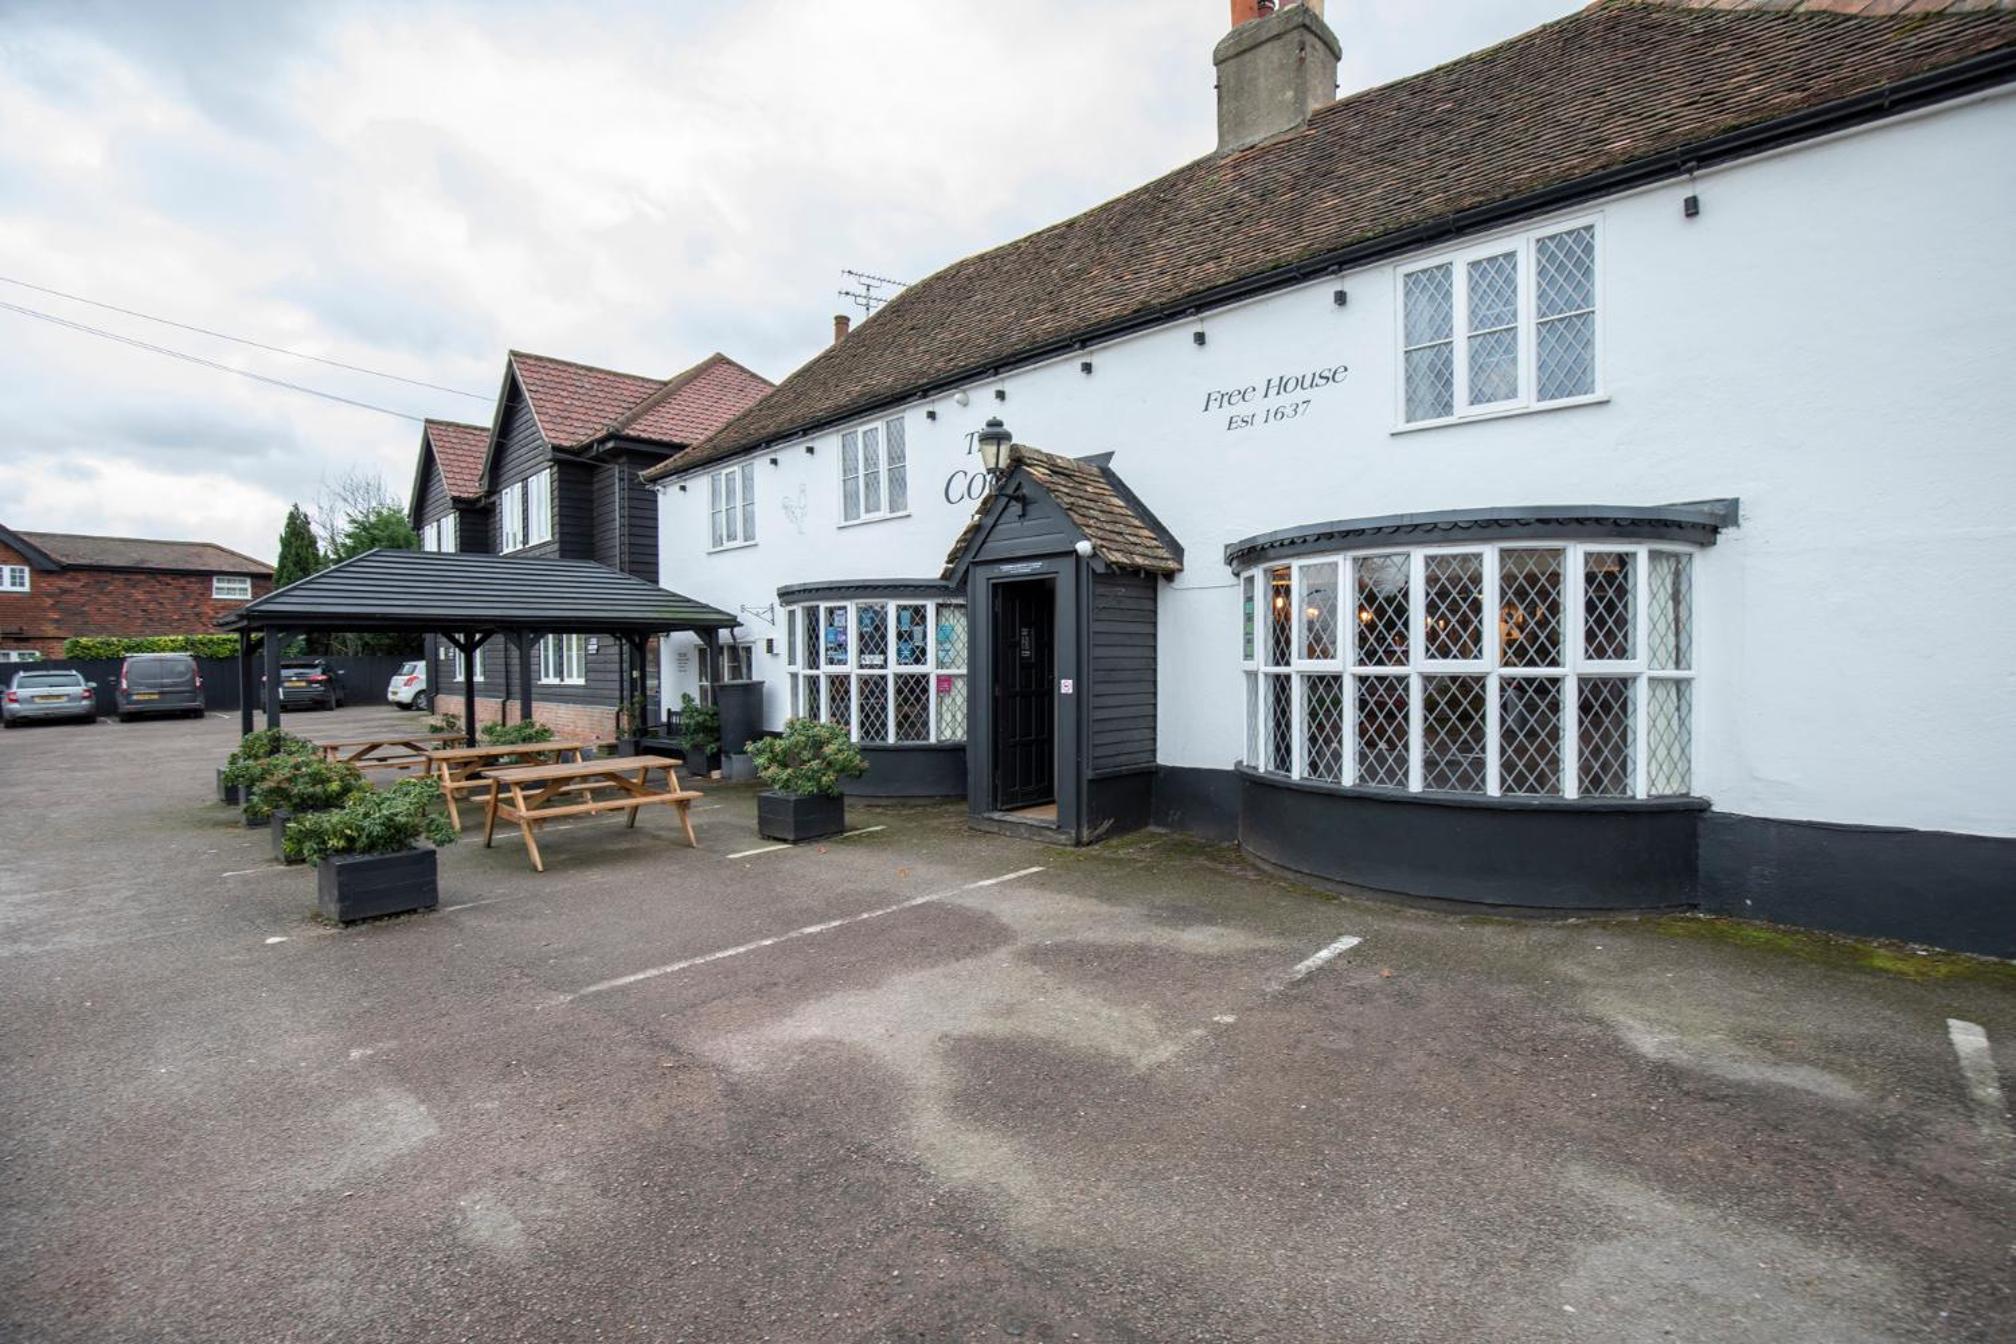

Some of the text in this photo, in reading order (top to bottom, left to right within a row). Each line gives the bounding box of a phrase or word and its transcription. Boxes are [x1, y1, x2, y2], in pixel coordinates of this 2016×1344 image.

[1202, 364, 1349, 413] Free House
[1263, 400, 1311, 424] 1637
